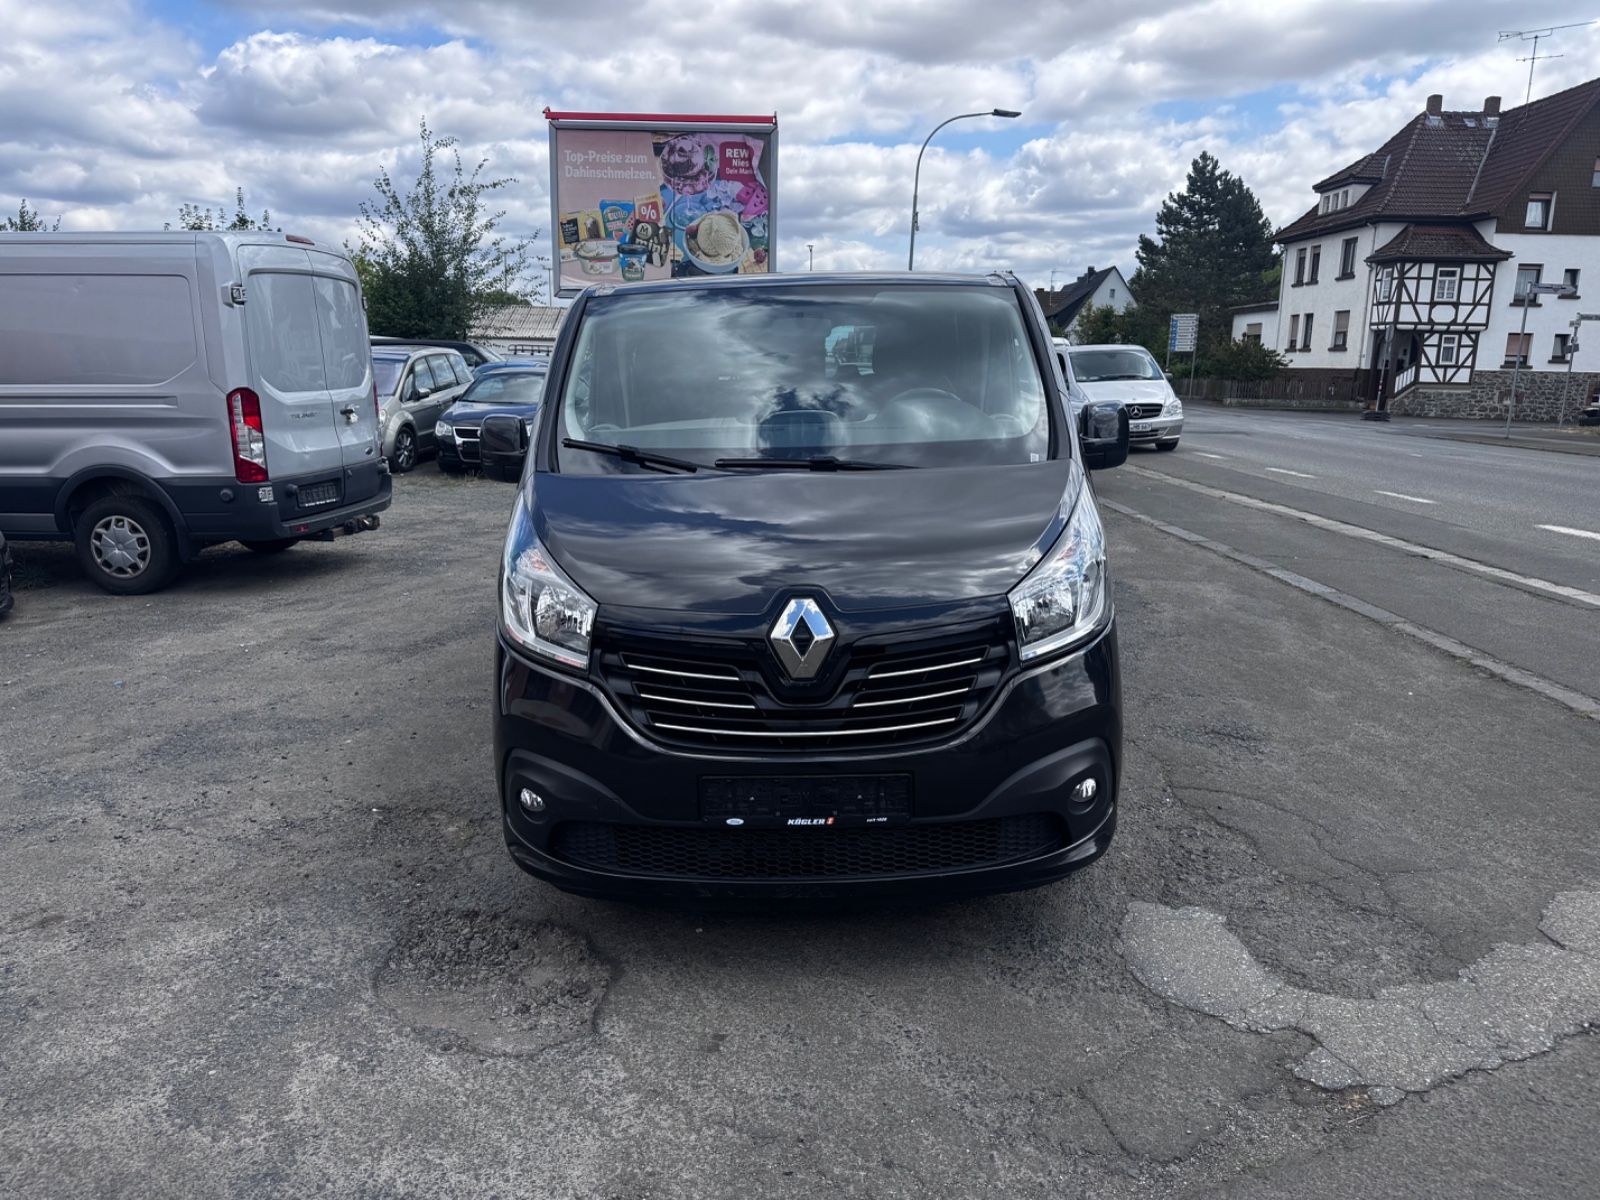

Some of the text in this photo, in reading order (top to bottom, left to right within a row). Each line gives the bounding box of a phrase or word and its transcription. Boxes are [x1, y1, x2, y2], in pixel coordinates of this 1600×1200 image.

[564, 150, 647, 165] Top-Preise zum
[565, 165, 656, 180] Dahinschmelzen.
